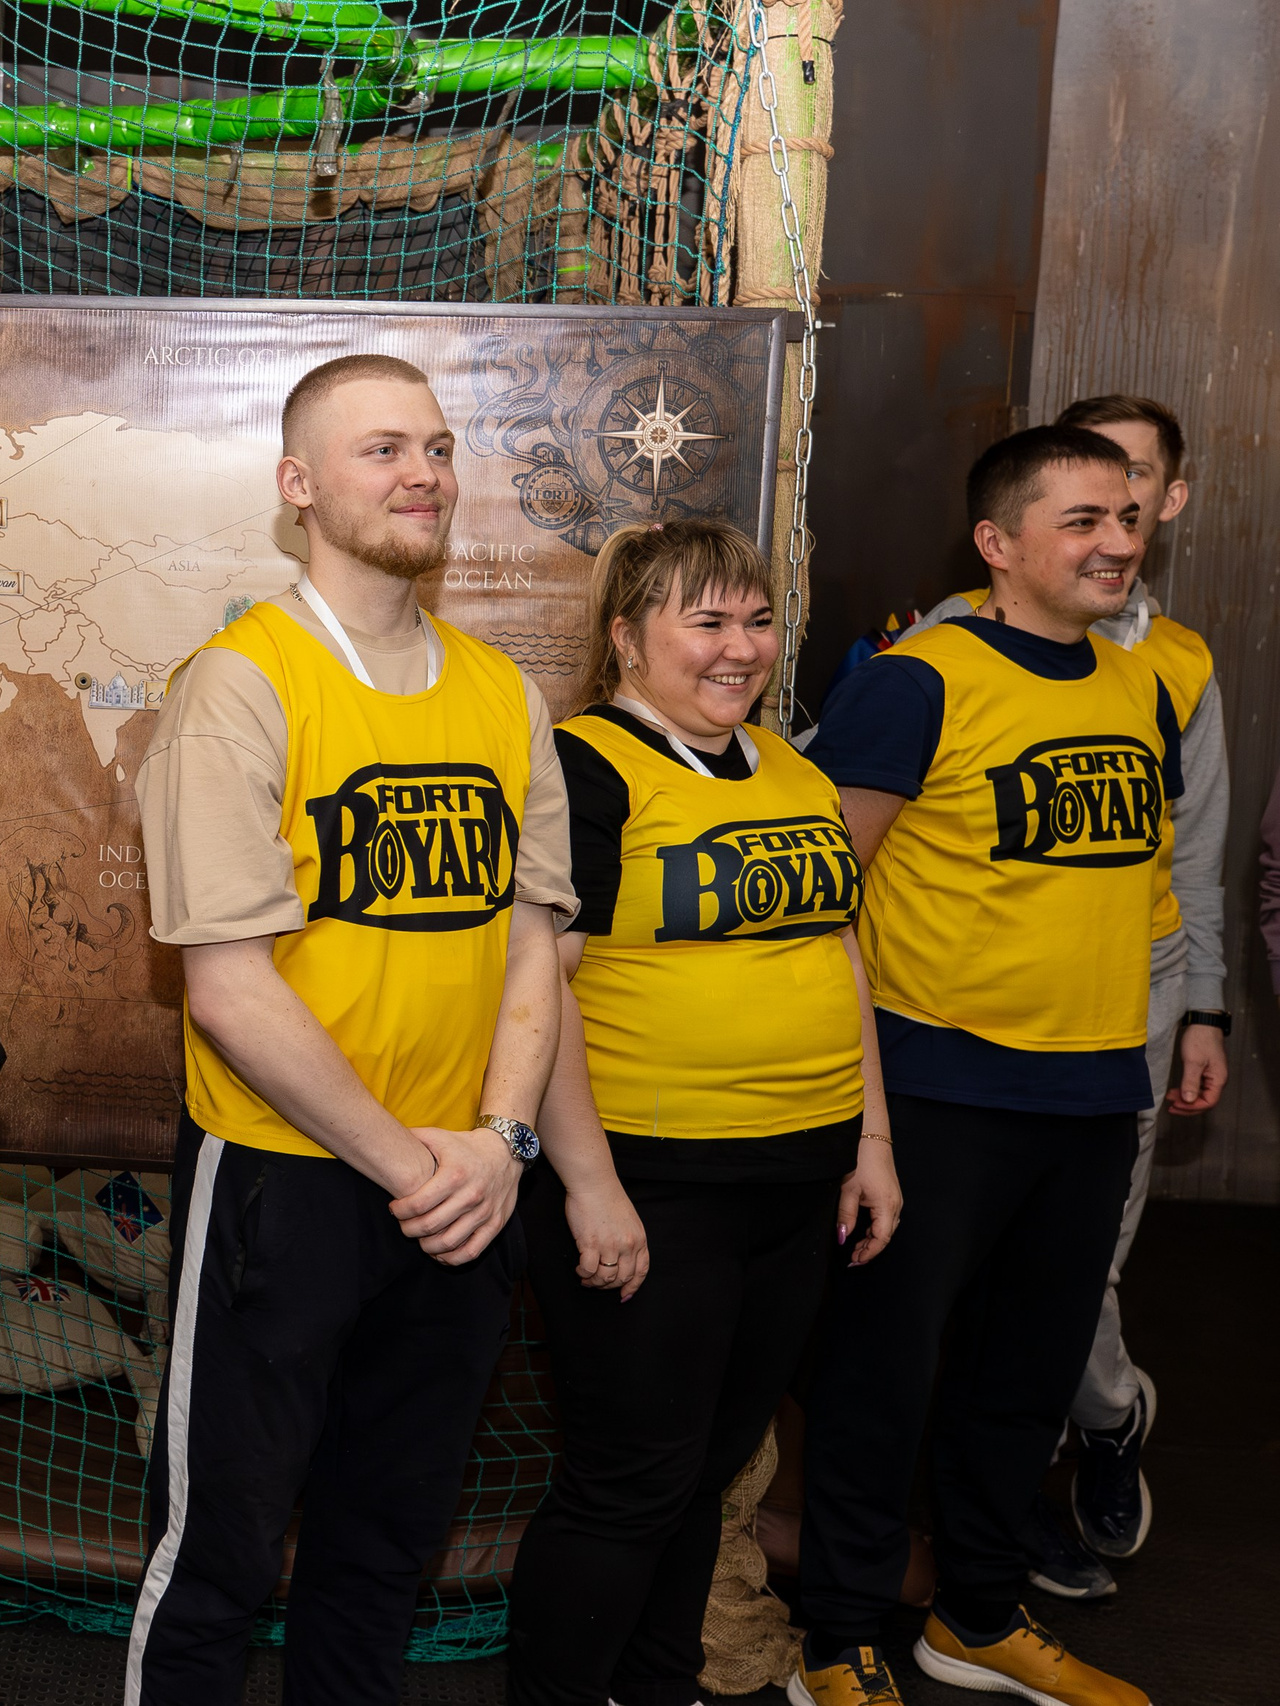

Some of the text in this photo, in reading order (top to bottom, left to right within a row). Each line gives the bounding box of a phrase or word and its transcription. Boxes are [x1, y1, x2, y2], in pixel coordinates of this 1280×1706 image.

[143, 346, 230, 366] ARCTIC
[168, 560, 201, 572] ASIA
[443, 542, 536, 563] PACIFIC
[444, 569, 533, 590] OCEAN
[1049, 751, 1137, 778] FORT
[376, 783, 477, 815] FORT
[985, 754, 1163, 862] BOYARD
[305, 785, 519, 923] BOYARD
[735, 827, 841, 857] FORT
